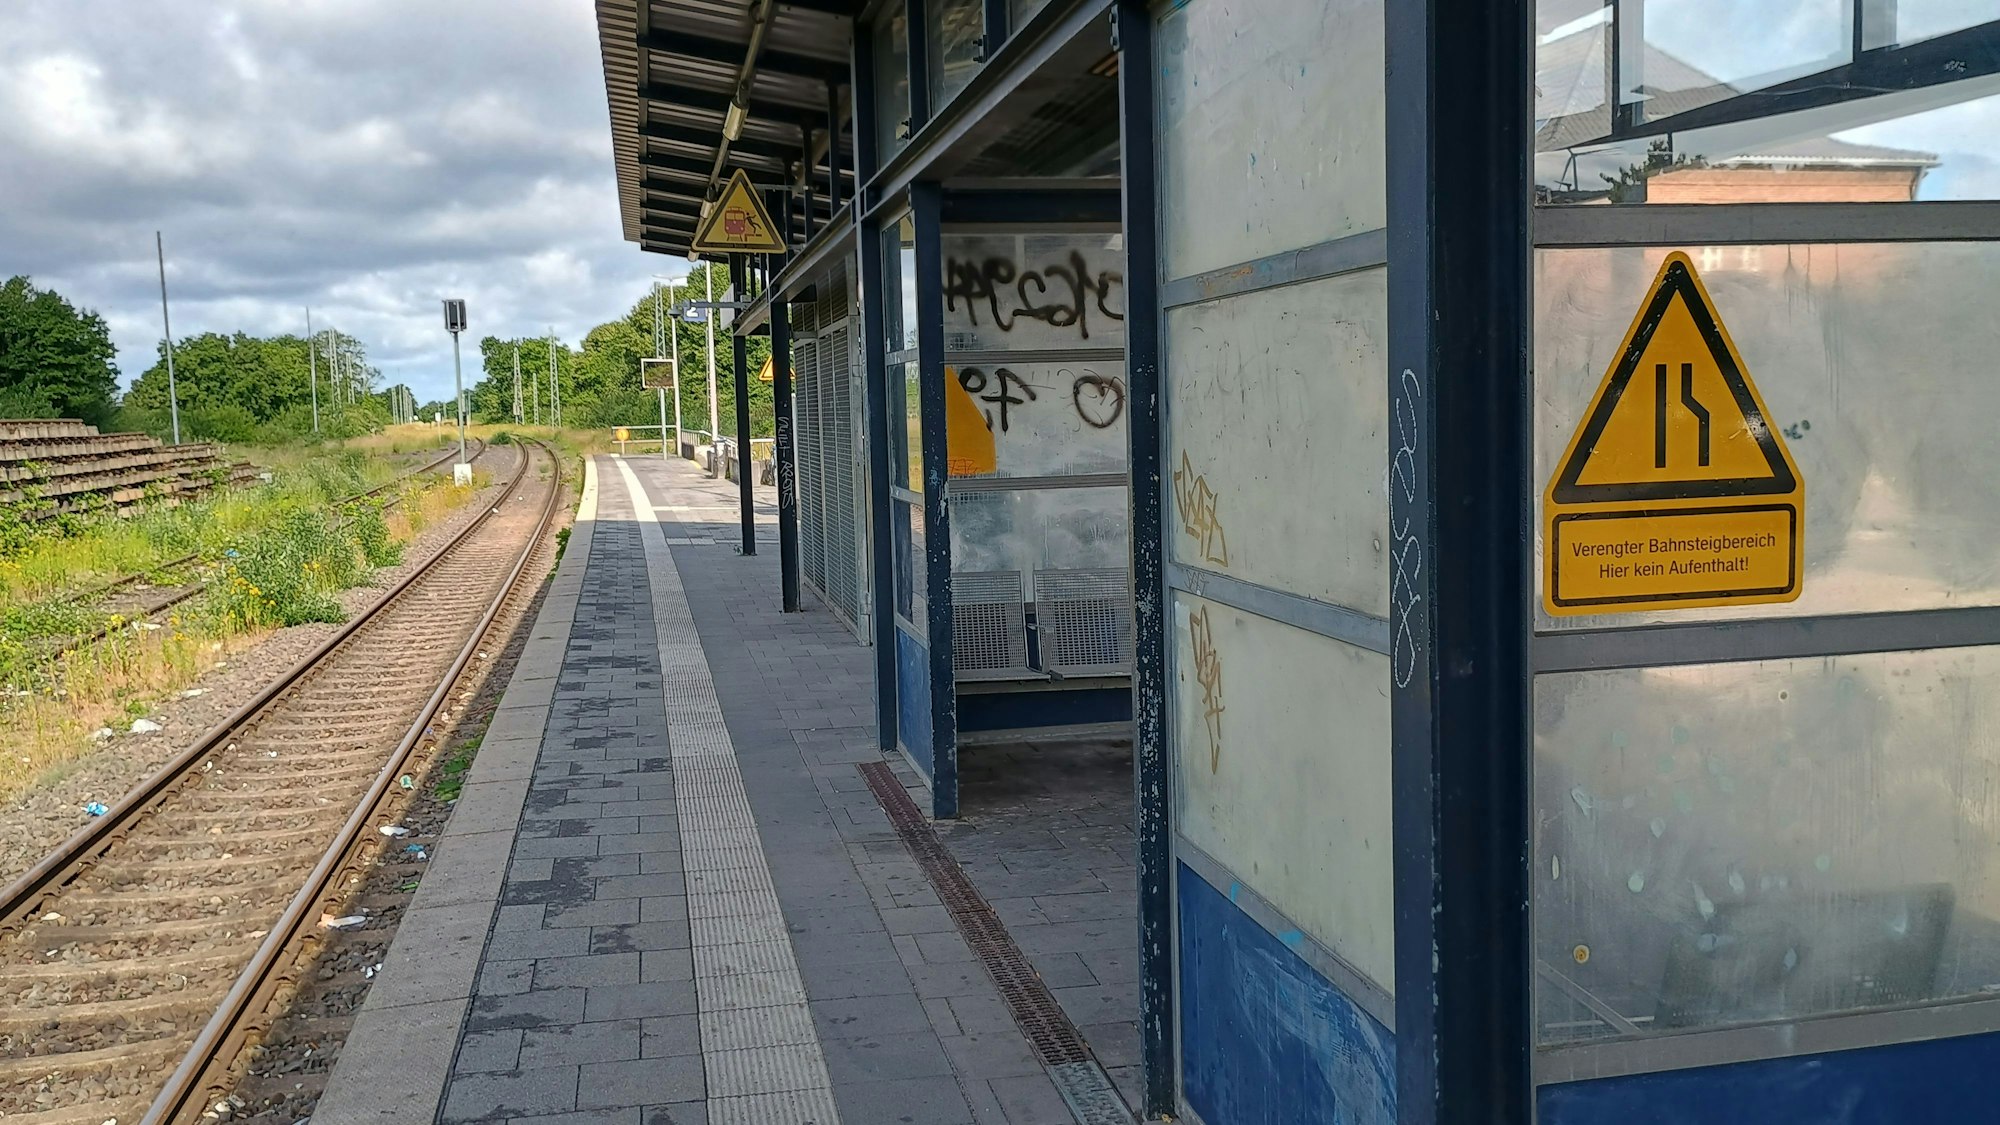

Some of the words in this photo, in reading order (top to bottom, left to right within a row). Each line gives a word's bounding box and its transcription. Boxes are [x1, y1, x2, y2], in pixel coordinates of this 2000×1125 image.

[1572, 540, 1645, 559] Verengter
[1649, 532, 1776, 554] Bahnsteigbereich
[1599, 563, 1630, 579] Hier
[1634, 561, 1664, 577] kein
[1669, 556, 1749, 575] Aufenthalt!
